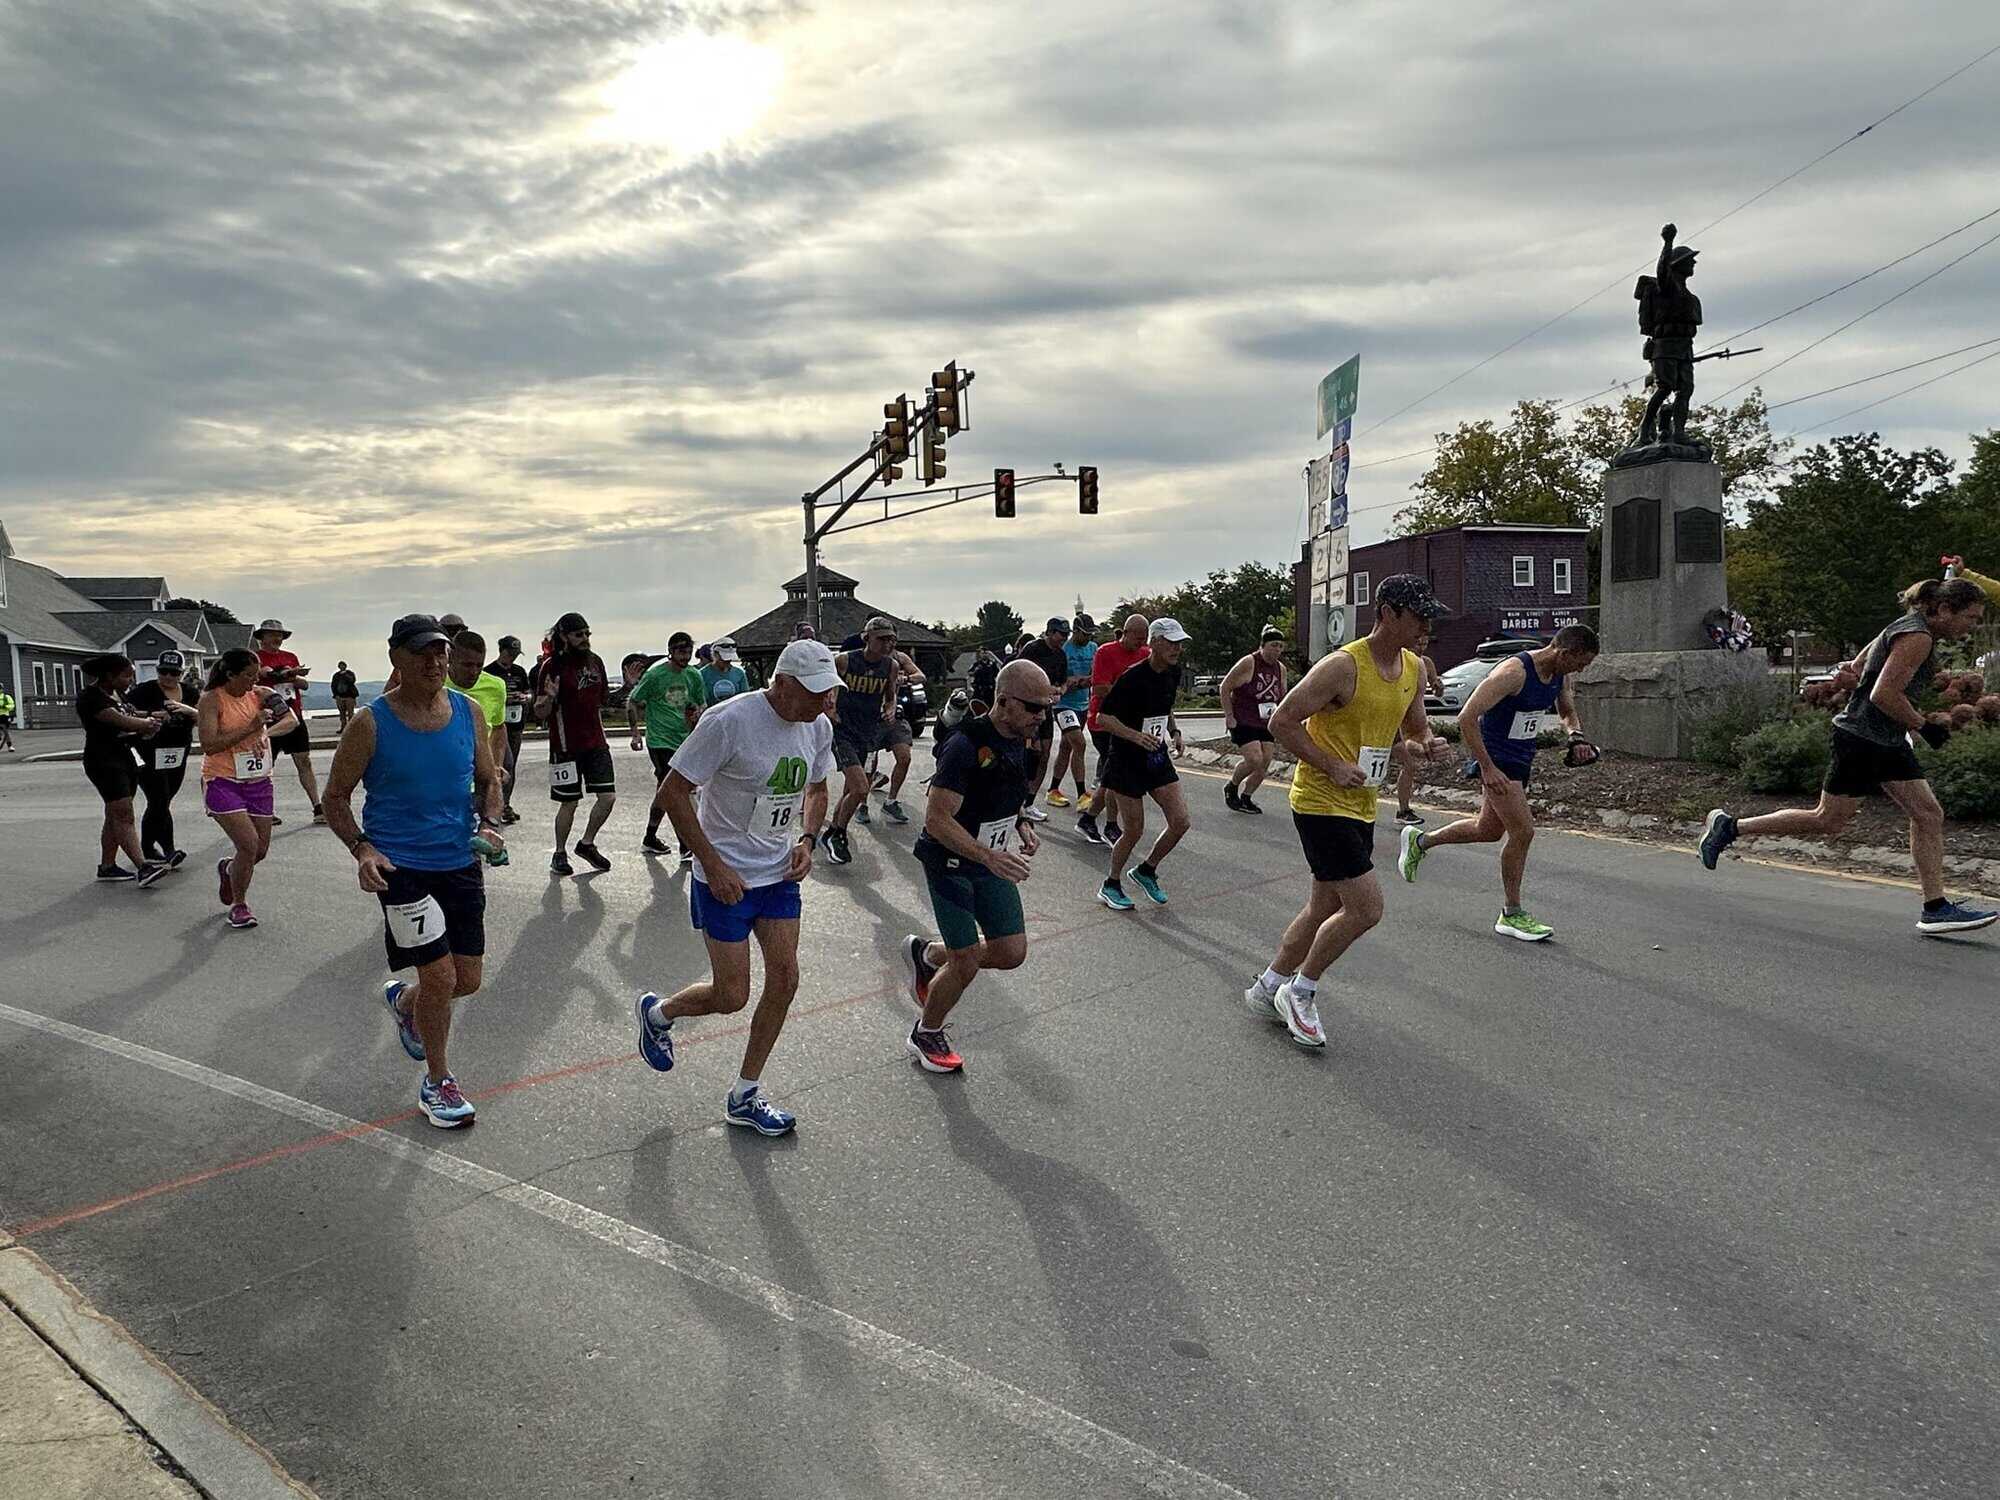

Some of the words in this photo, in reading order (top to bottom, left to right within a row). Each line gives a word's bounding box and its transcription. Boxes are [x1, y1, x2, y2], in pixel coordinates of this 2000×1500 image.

[1334, 460, 1347, 485] 95
[1316, 548, 1324, 573] 2
[1335, 542, 1343, 565] 6
[1502, 619, 1540, 629] BARBER
[1553, 617, 1578, 628] SHOP
[845, 672, 888, 694] NAVY
[1150, 725, 1162, 737] 12
[1524, 720, 1537, 733] 15
[164, 754, 177, 765] 25
[247, 758, 263, 772] 26
[1371, 760, 1385, 778] 11
[554, 769, 569, 781] 10
[767, 757, 807, 795] 40
[770, 807, 791, 828] 18
[990, 830, 1007, 849] 14
[411, 914, 425, 935] 7
